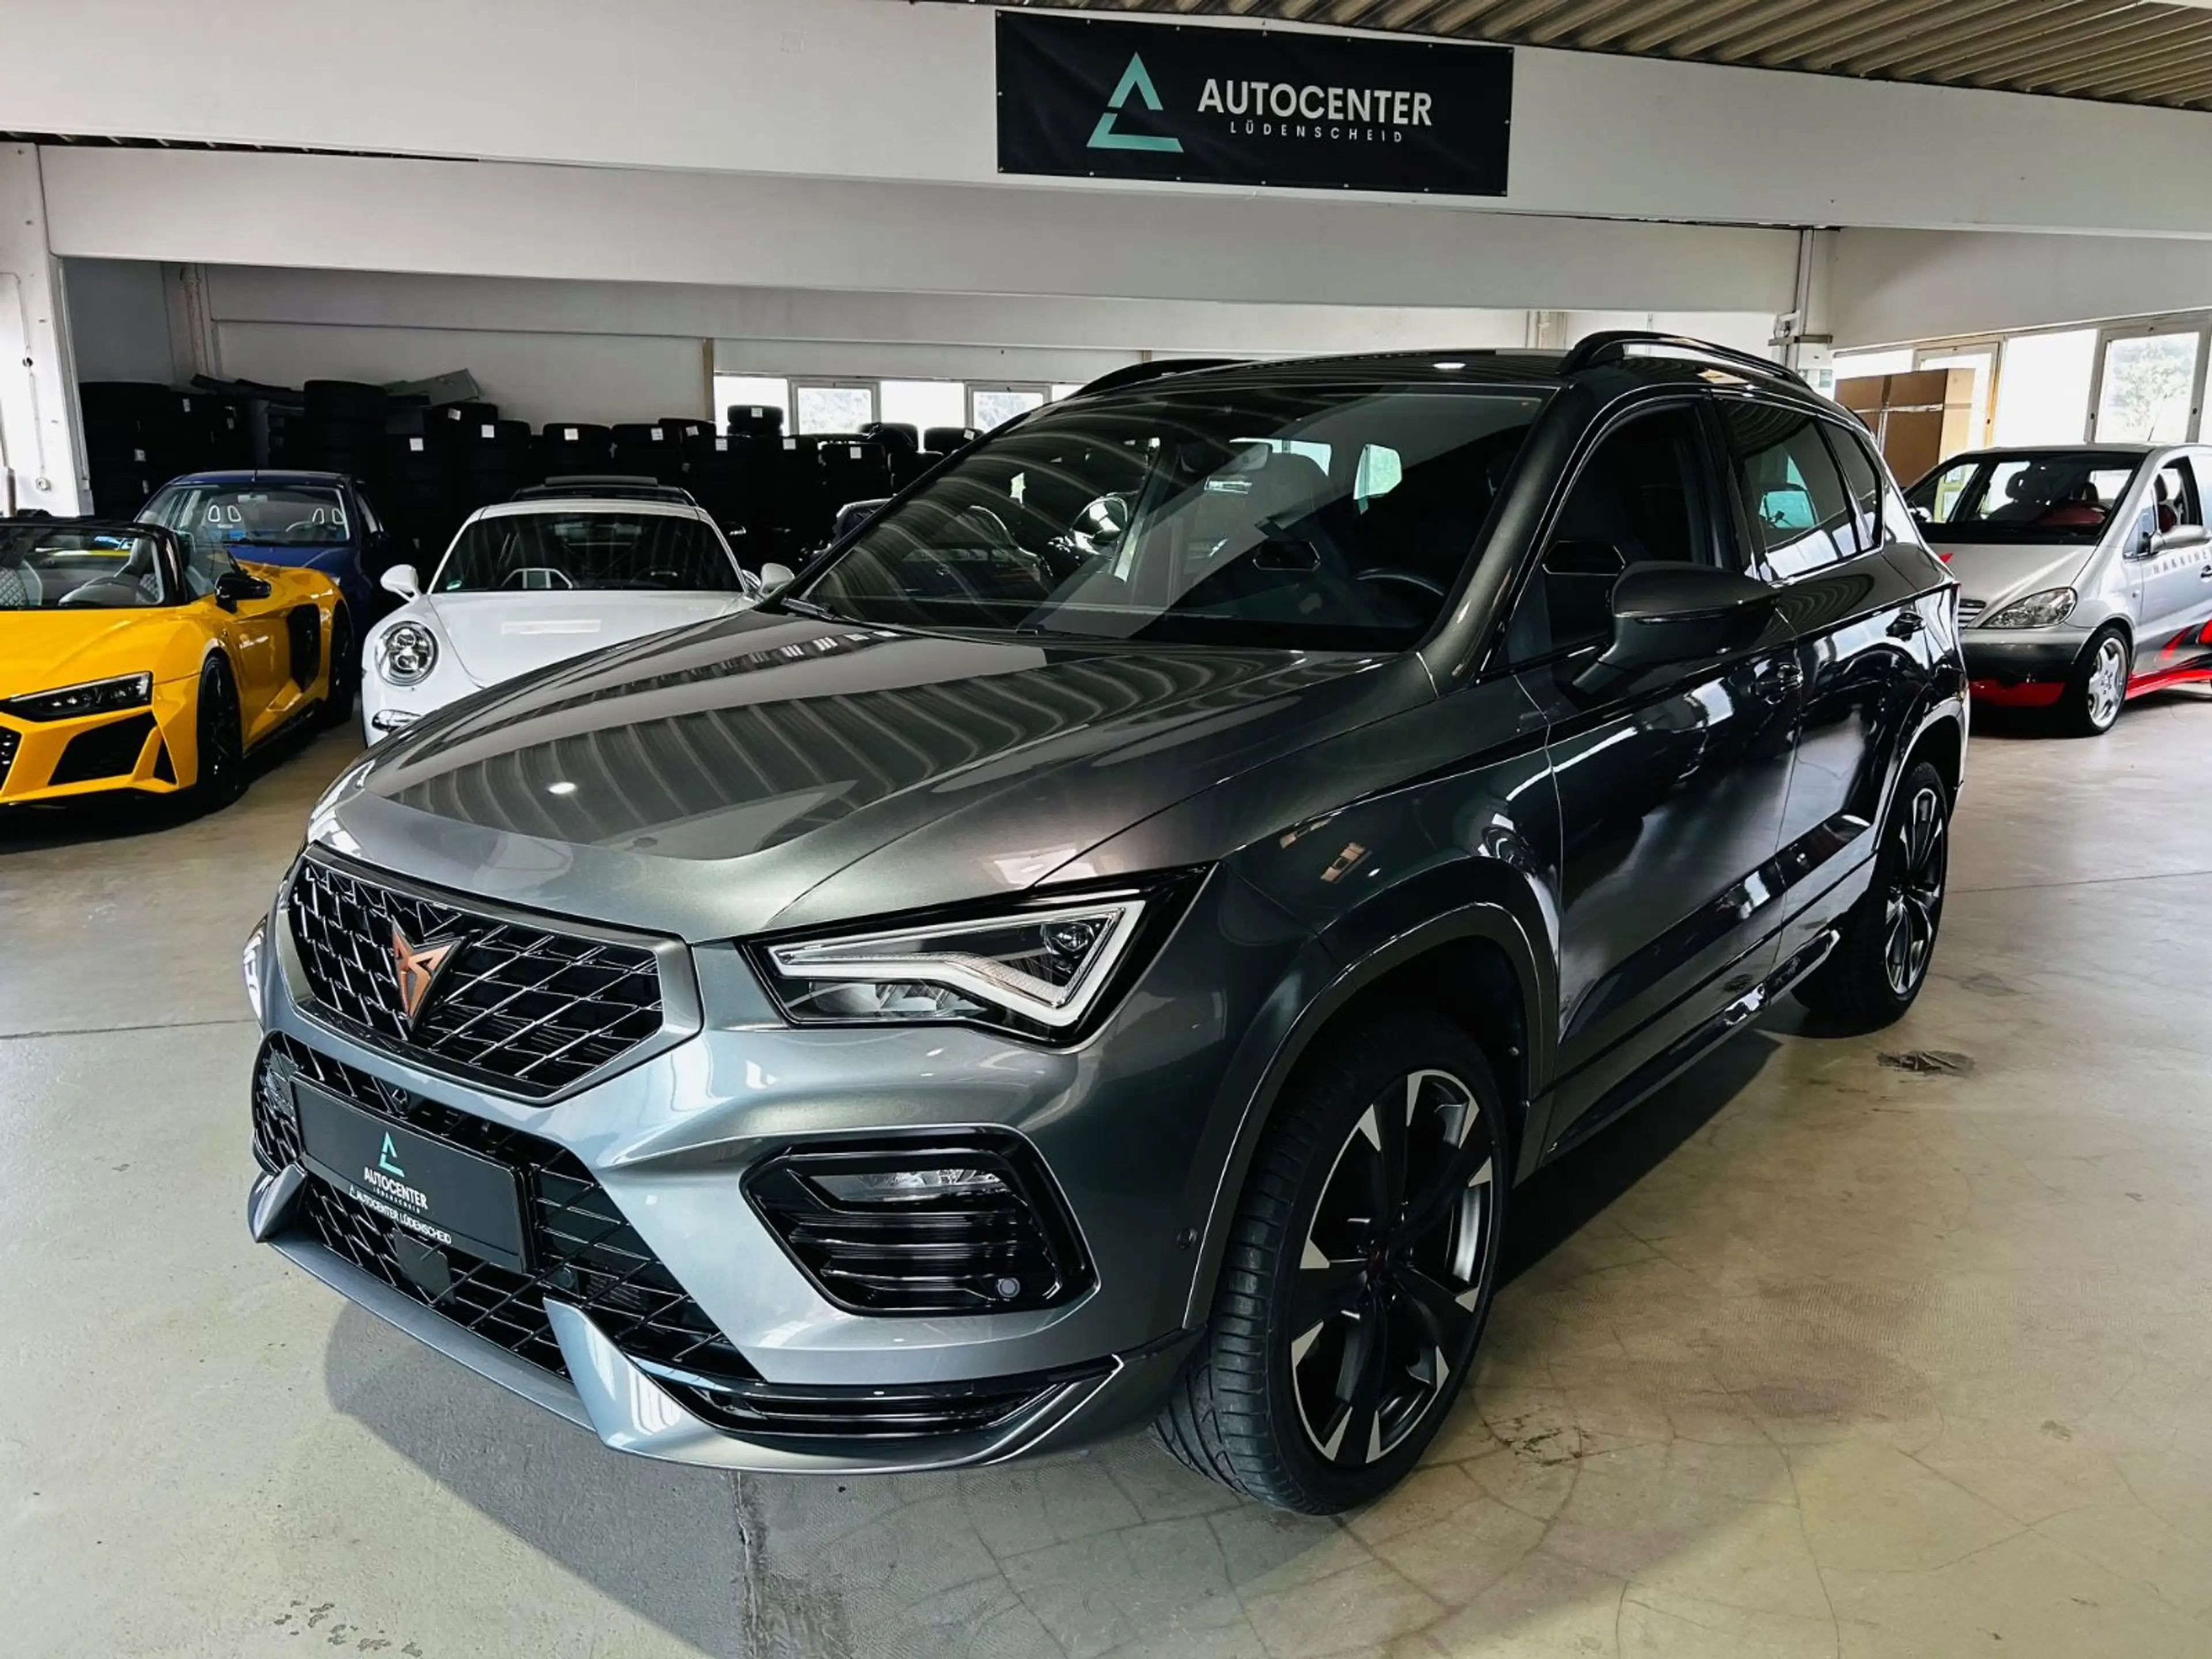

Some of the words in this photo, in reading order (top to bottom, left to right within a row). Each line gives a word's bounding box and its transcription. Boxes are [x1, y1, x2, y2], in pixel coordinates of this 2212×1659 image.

[1197, 78, 1433, 126] AUTOCENTER
[1230, 119, 1402, 142] LÜDENSCHEID
[364, 1166, 428, 1210] AUTOCENTER
